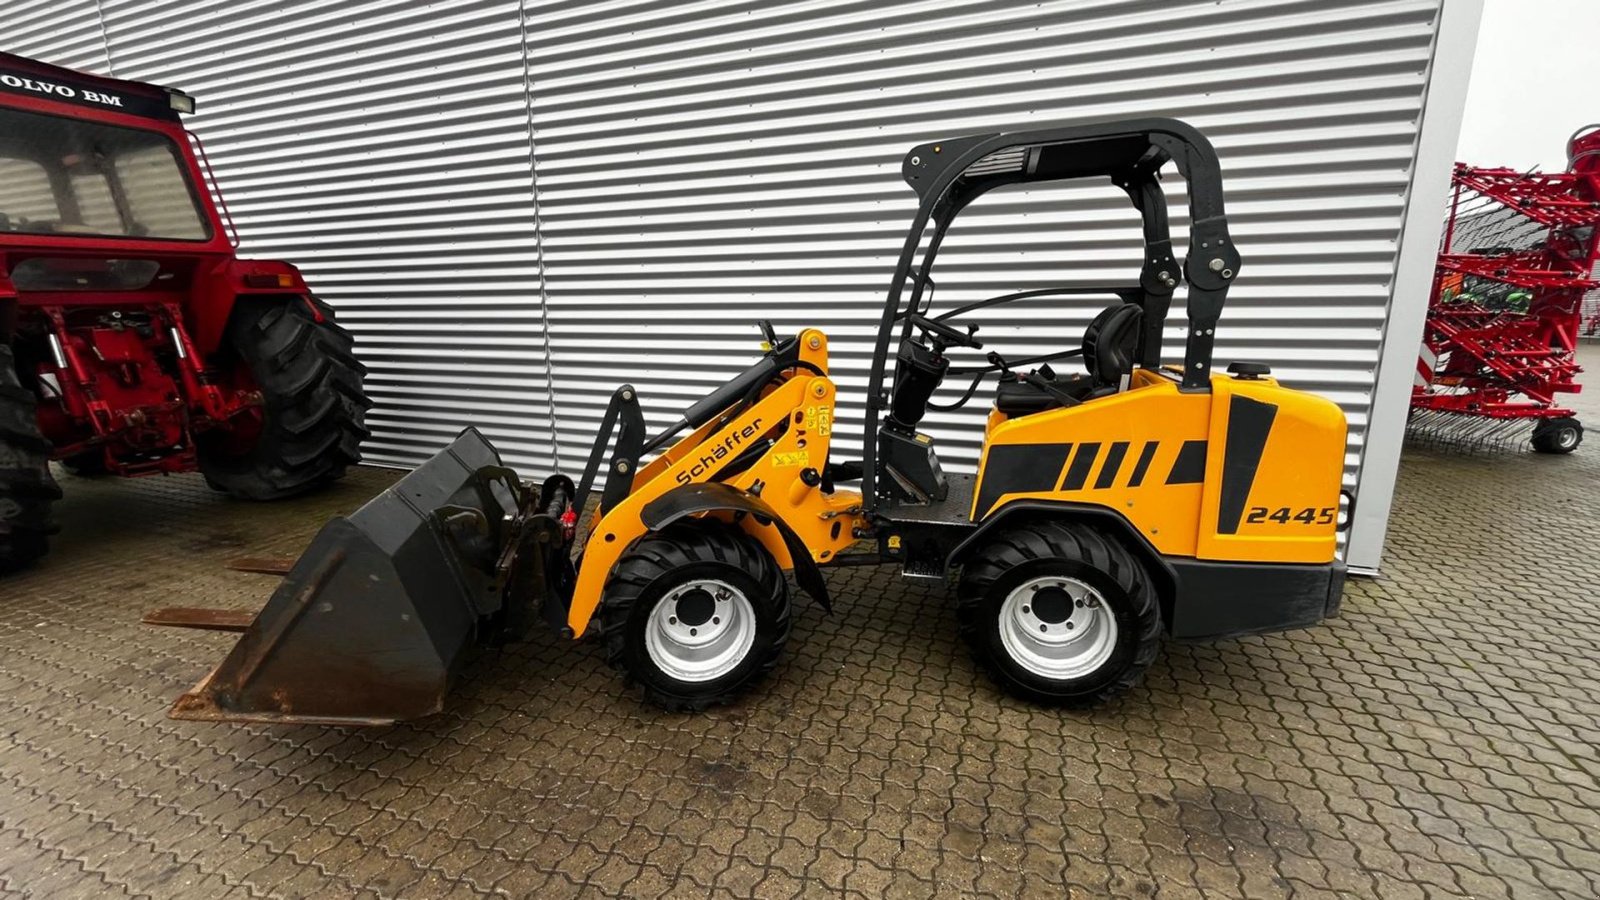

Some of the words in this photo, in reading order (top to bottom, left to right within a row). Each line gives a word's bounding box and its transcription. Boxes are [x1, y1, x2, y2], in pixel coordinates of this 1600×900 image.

[0, 74, 75, 98] OLVO
[81, 89, 124, 107] BM
[676, 418, 763, 485] Schäffer
[1246, 507, 1335, 525] 2445
